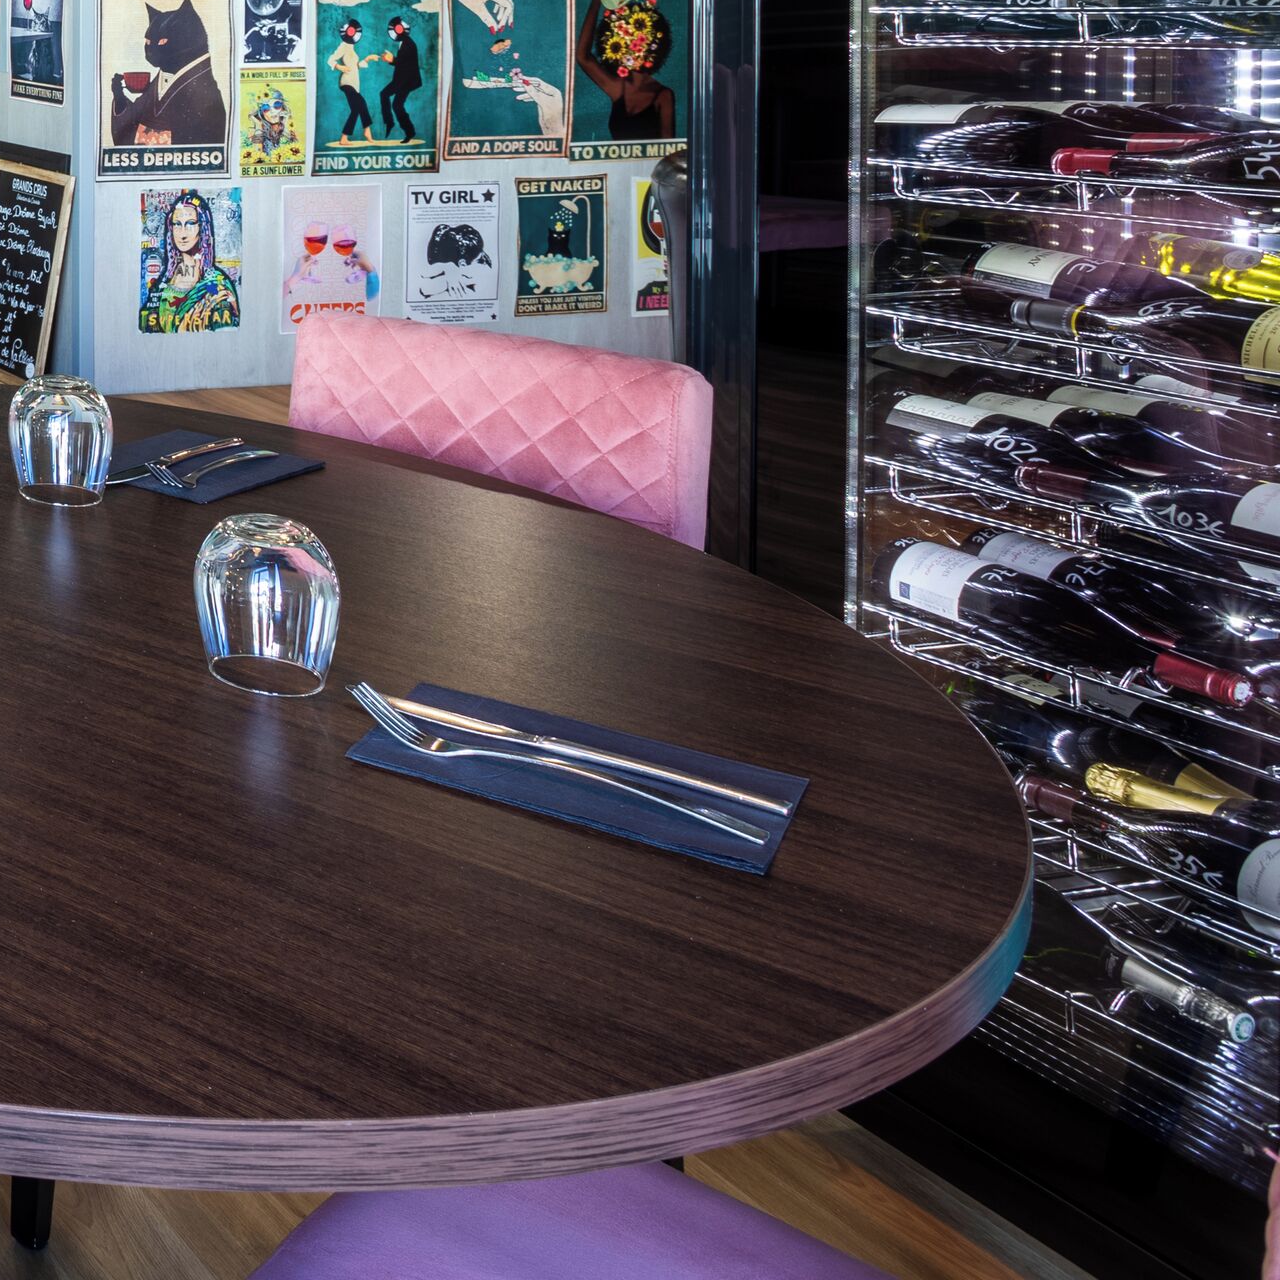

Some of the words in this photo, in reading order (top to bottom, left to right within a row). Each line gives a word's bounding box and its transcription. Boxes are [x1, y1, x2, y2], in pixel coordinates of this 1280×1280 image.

[52, 90, 63, 100] FINE
[452, 142, 480, 154] AND
[481, 142, 491, 153] A
[493, 141, 526, 153] DOPE
[528, 139, 559, 152] SOUL
[571, 146, 594, 160] TO
[597, 144, 643, 159] YOUR
[104, 151, 139, 167] LESS
[143, 151, 223, 167] DEPRESSO
[315, 156, 348, 170] FIND
[352, 155, 391, 169] YOUR
[395, 154, 433, 168] SOUL
[241, 167, 251, 176] BE
[252, 167, 259, 176] A
[259, 166, 303, 176] SUNFLOWER
[12, 178, 33, 194] GRANDS
[33, 183, 48, 197] CRUS
[519, 181, 547, 193] GET
[550, 179, 602, 192] NAKED
[411, 191, 434, 205] TV
[439, 190, 479, 204] GIRL
[518, 297, 539, 305] UNLESS
[518, 304, 543, 312] DON'T
[544, 303, 568, 311] MAKE
[569, 302, 576, 310] IT
[577, 301, 602, 310] WEIRD
[639, 296, 643, 308] I
[148, 309, 232, 327] SUPERSTAR
[1243, 328, 1258, 366] MICHEL
[983, 426, 1050, 464] 102
[1157, 503, 1226, 538] 103€
